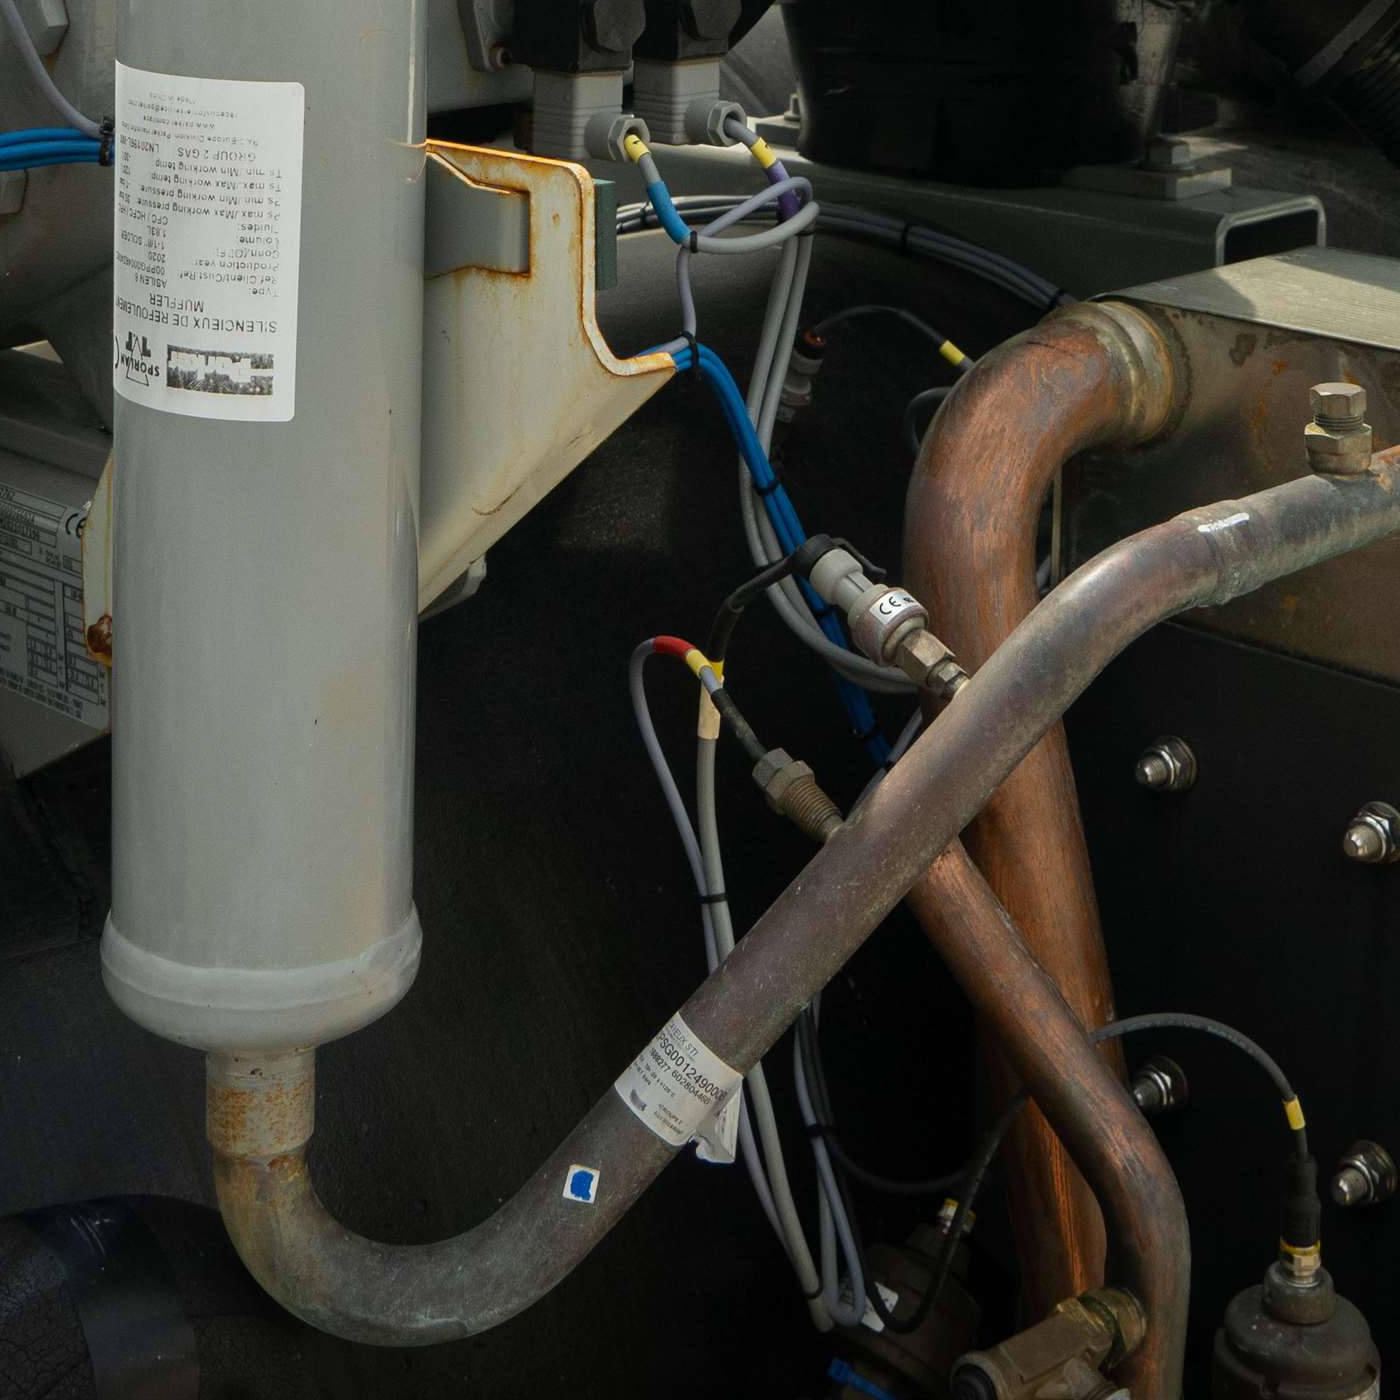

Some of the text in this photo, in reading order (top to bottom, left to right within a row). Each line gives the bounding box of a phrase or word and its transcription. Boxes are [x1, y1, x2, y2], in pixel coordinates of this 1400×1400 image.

[177, 147, 256, 162] GROUP 2 GAS
[178, 161, 218, 176] working
[177, 188, 216, 201] working
[173, 202, 211, 216] working
[151, 214, 169, 226] CFC
[147, 251, 166, 264] 2020
[220, 260, 280, 272] Production
[149, 293, 205, 313] MUFFLER
[172, 313, 189, 328] DE
[193, 318, 278, 334] SILENCIEUX
[120, 352, 161, 378] SPORLAN
[879, 596, 902, 615] CE
